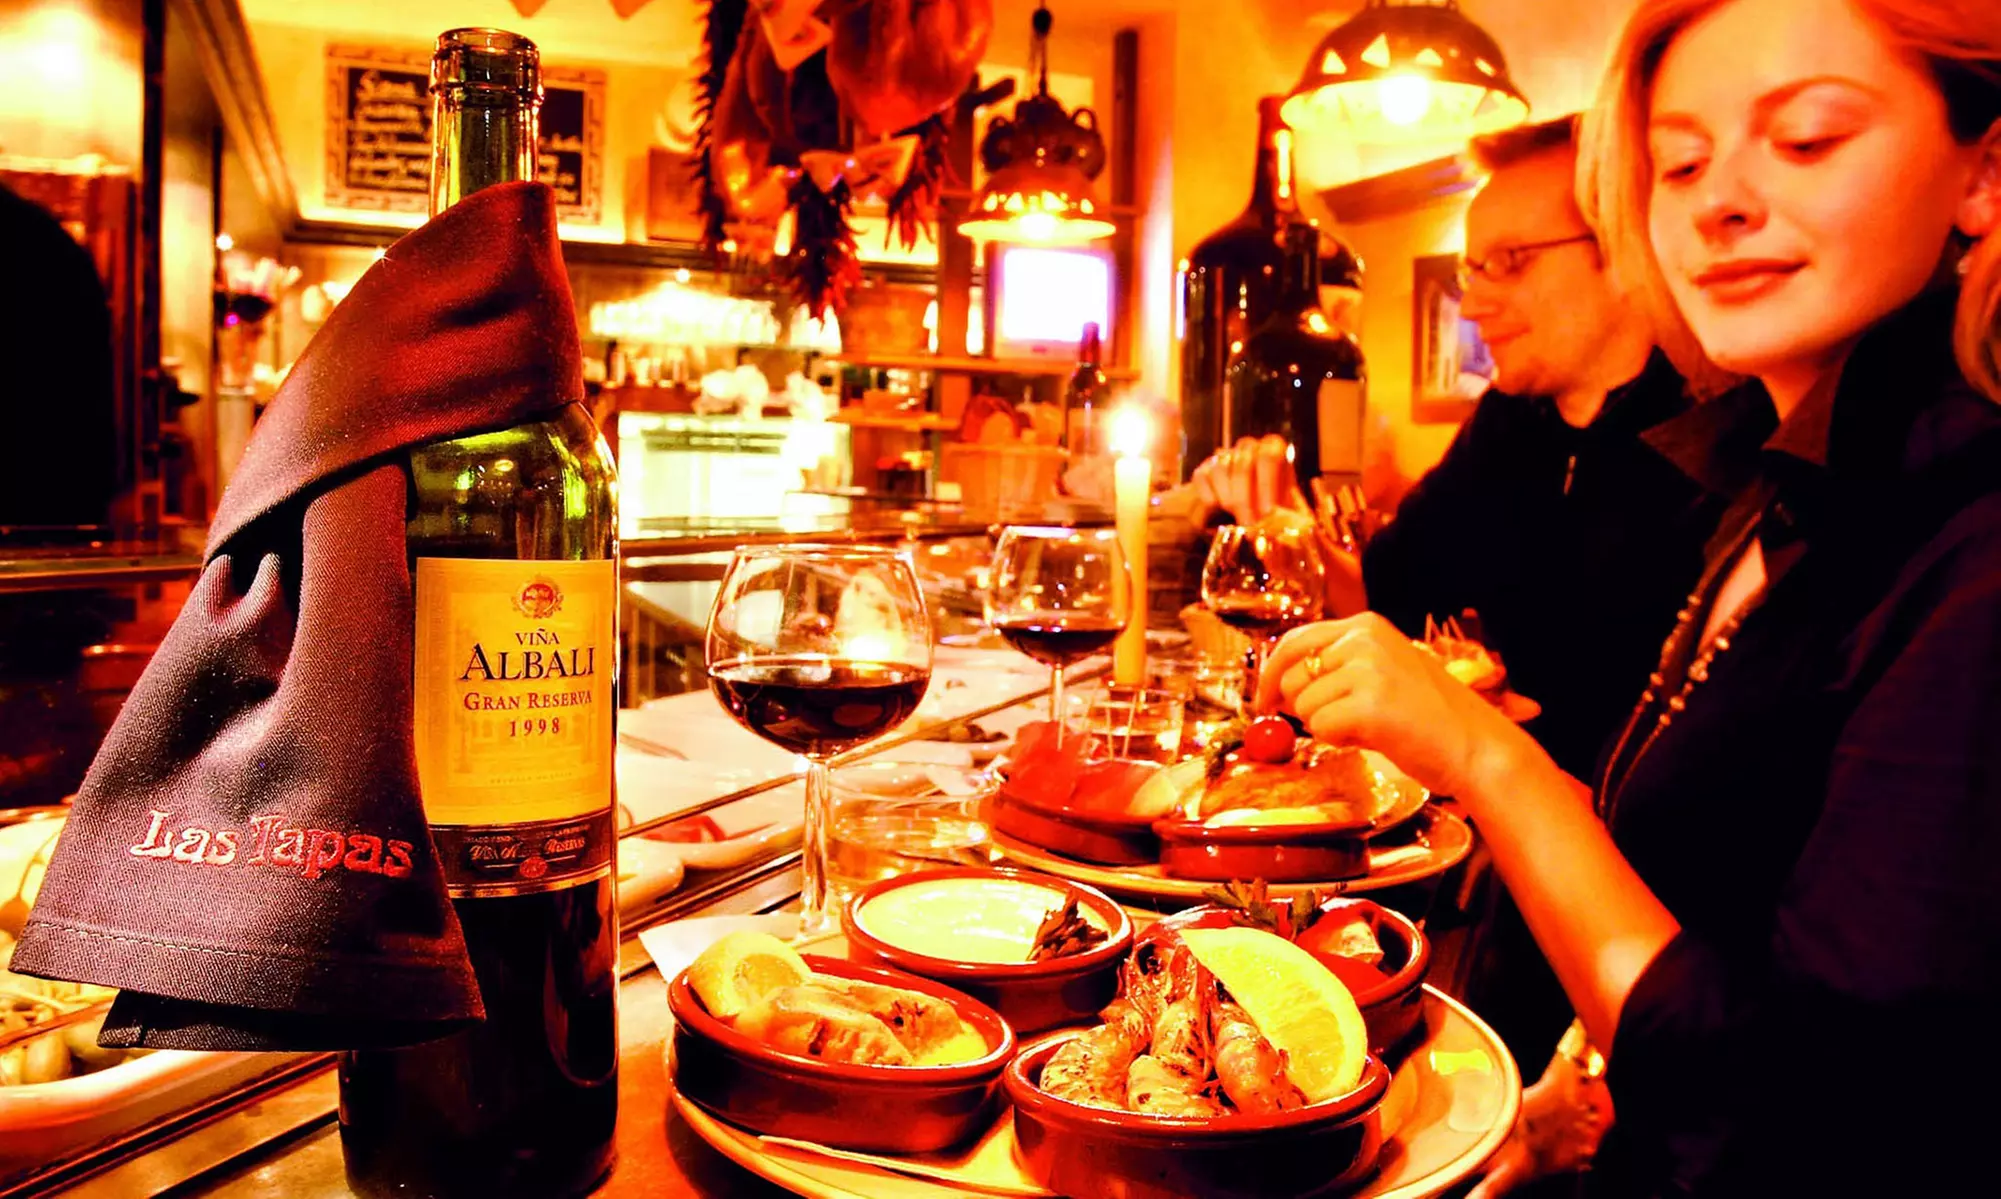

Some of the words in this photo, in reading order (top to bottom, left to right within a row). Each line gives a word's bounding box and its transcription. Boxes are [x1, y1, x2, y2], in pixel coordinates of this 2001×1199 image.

[515, 628, 560, 646] VIÑA
[460, 643, 595, 681] ALBALI
[463, 692, 521, 711] GRAN
[528, 688, 592, 709] RESERVA
[509, 717, 561, 738] 1998
[130, 810, 240, 868] Las
[248, 814, 415, 879] Tapas
